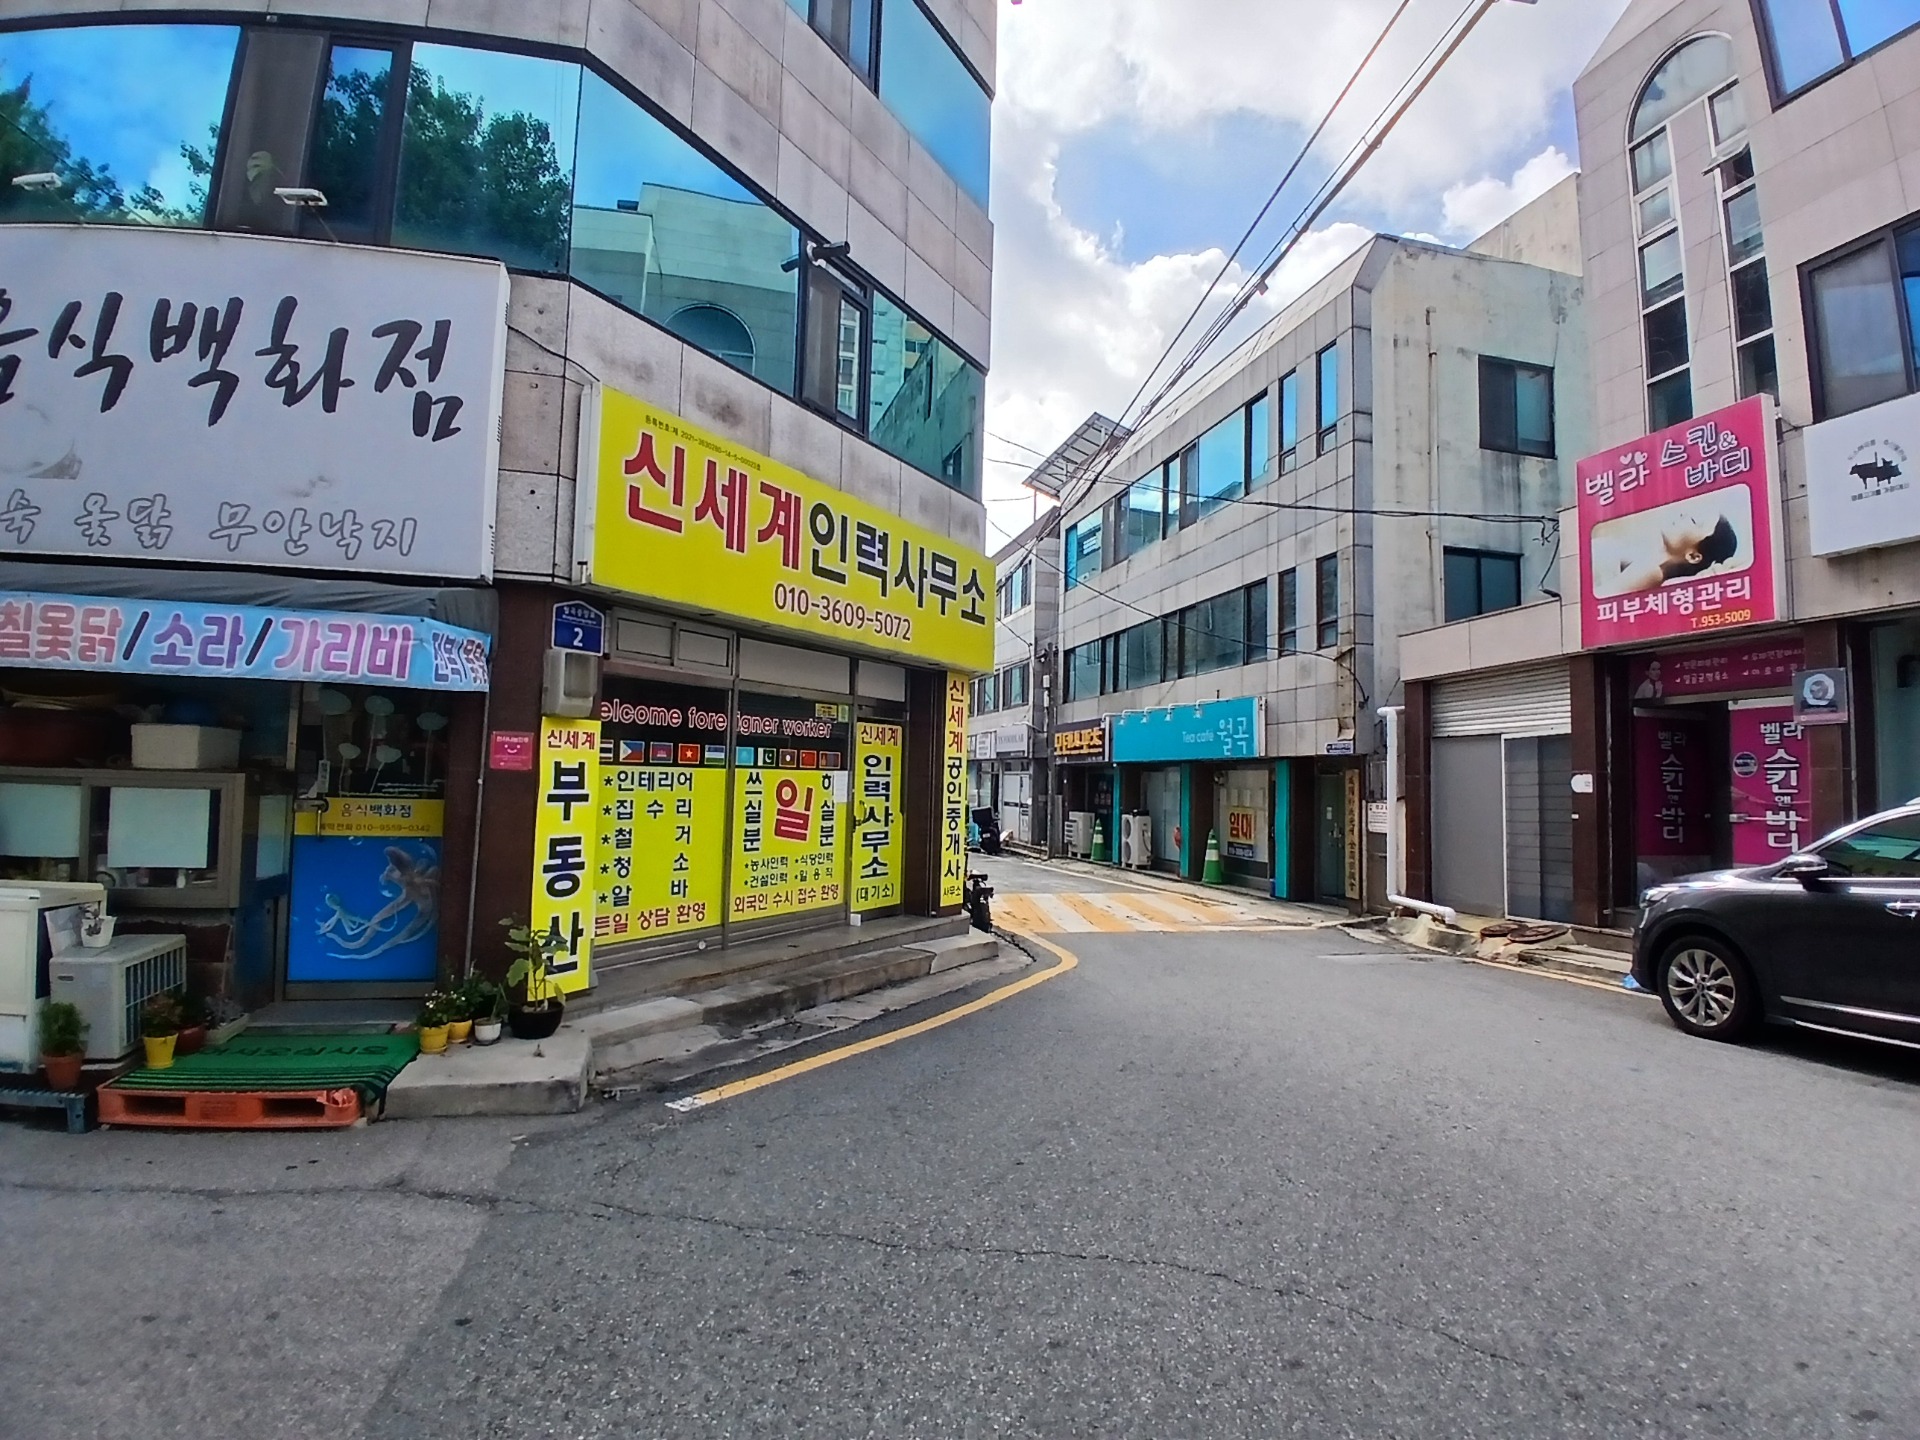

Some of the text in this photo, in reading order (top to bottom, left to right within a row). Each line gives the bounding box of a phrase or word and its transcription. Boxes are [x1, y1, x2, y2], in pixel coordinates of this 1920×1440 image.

[1685, 447, 1750, 489] 바디
[1585, 462, 1650, 506] 벨라
[208, 501, 417, 561] 무안낙지
[1596, 576, 1751, 624] 피부체형관리
[774, 582, 912, 642] 010-3609-5072
[1690, 608, 1752, 630] T.953-5009
[573, 627, 583, 647] 2
[547, 729, 596, 750] 신세계
[782, 718, 832, 739] worker
[861, 725, 899, 747] 신세계
[1182, 731, 1196, 743] Tea
[1760, 721, 1805, 745] 벨라
[616, 770, 693, 792] 인테리어
[341, 803, 411, 818] 음식백화점
[774, 778, 814, 842] 일
[860, 754, 894, 880] 인력사무소
[1229, 811, 1252, 840] 임대
[543, 760, 590, 976] 부동산
[750, 852, 834, 873] 농사인력 식당인력
[749, 872, 788, 889] 건설인력
[943, 885, 962, 897] 사무소
[733, 883, 839, 914] 외국인 수시 접수 환영
[856, 882, 895, 904] (대기소)
[637, 906, 671, 931] 상담
[676, 901, 706, 924] 환영
